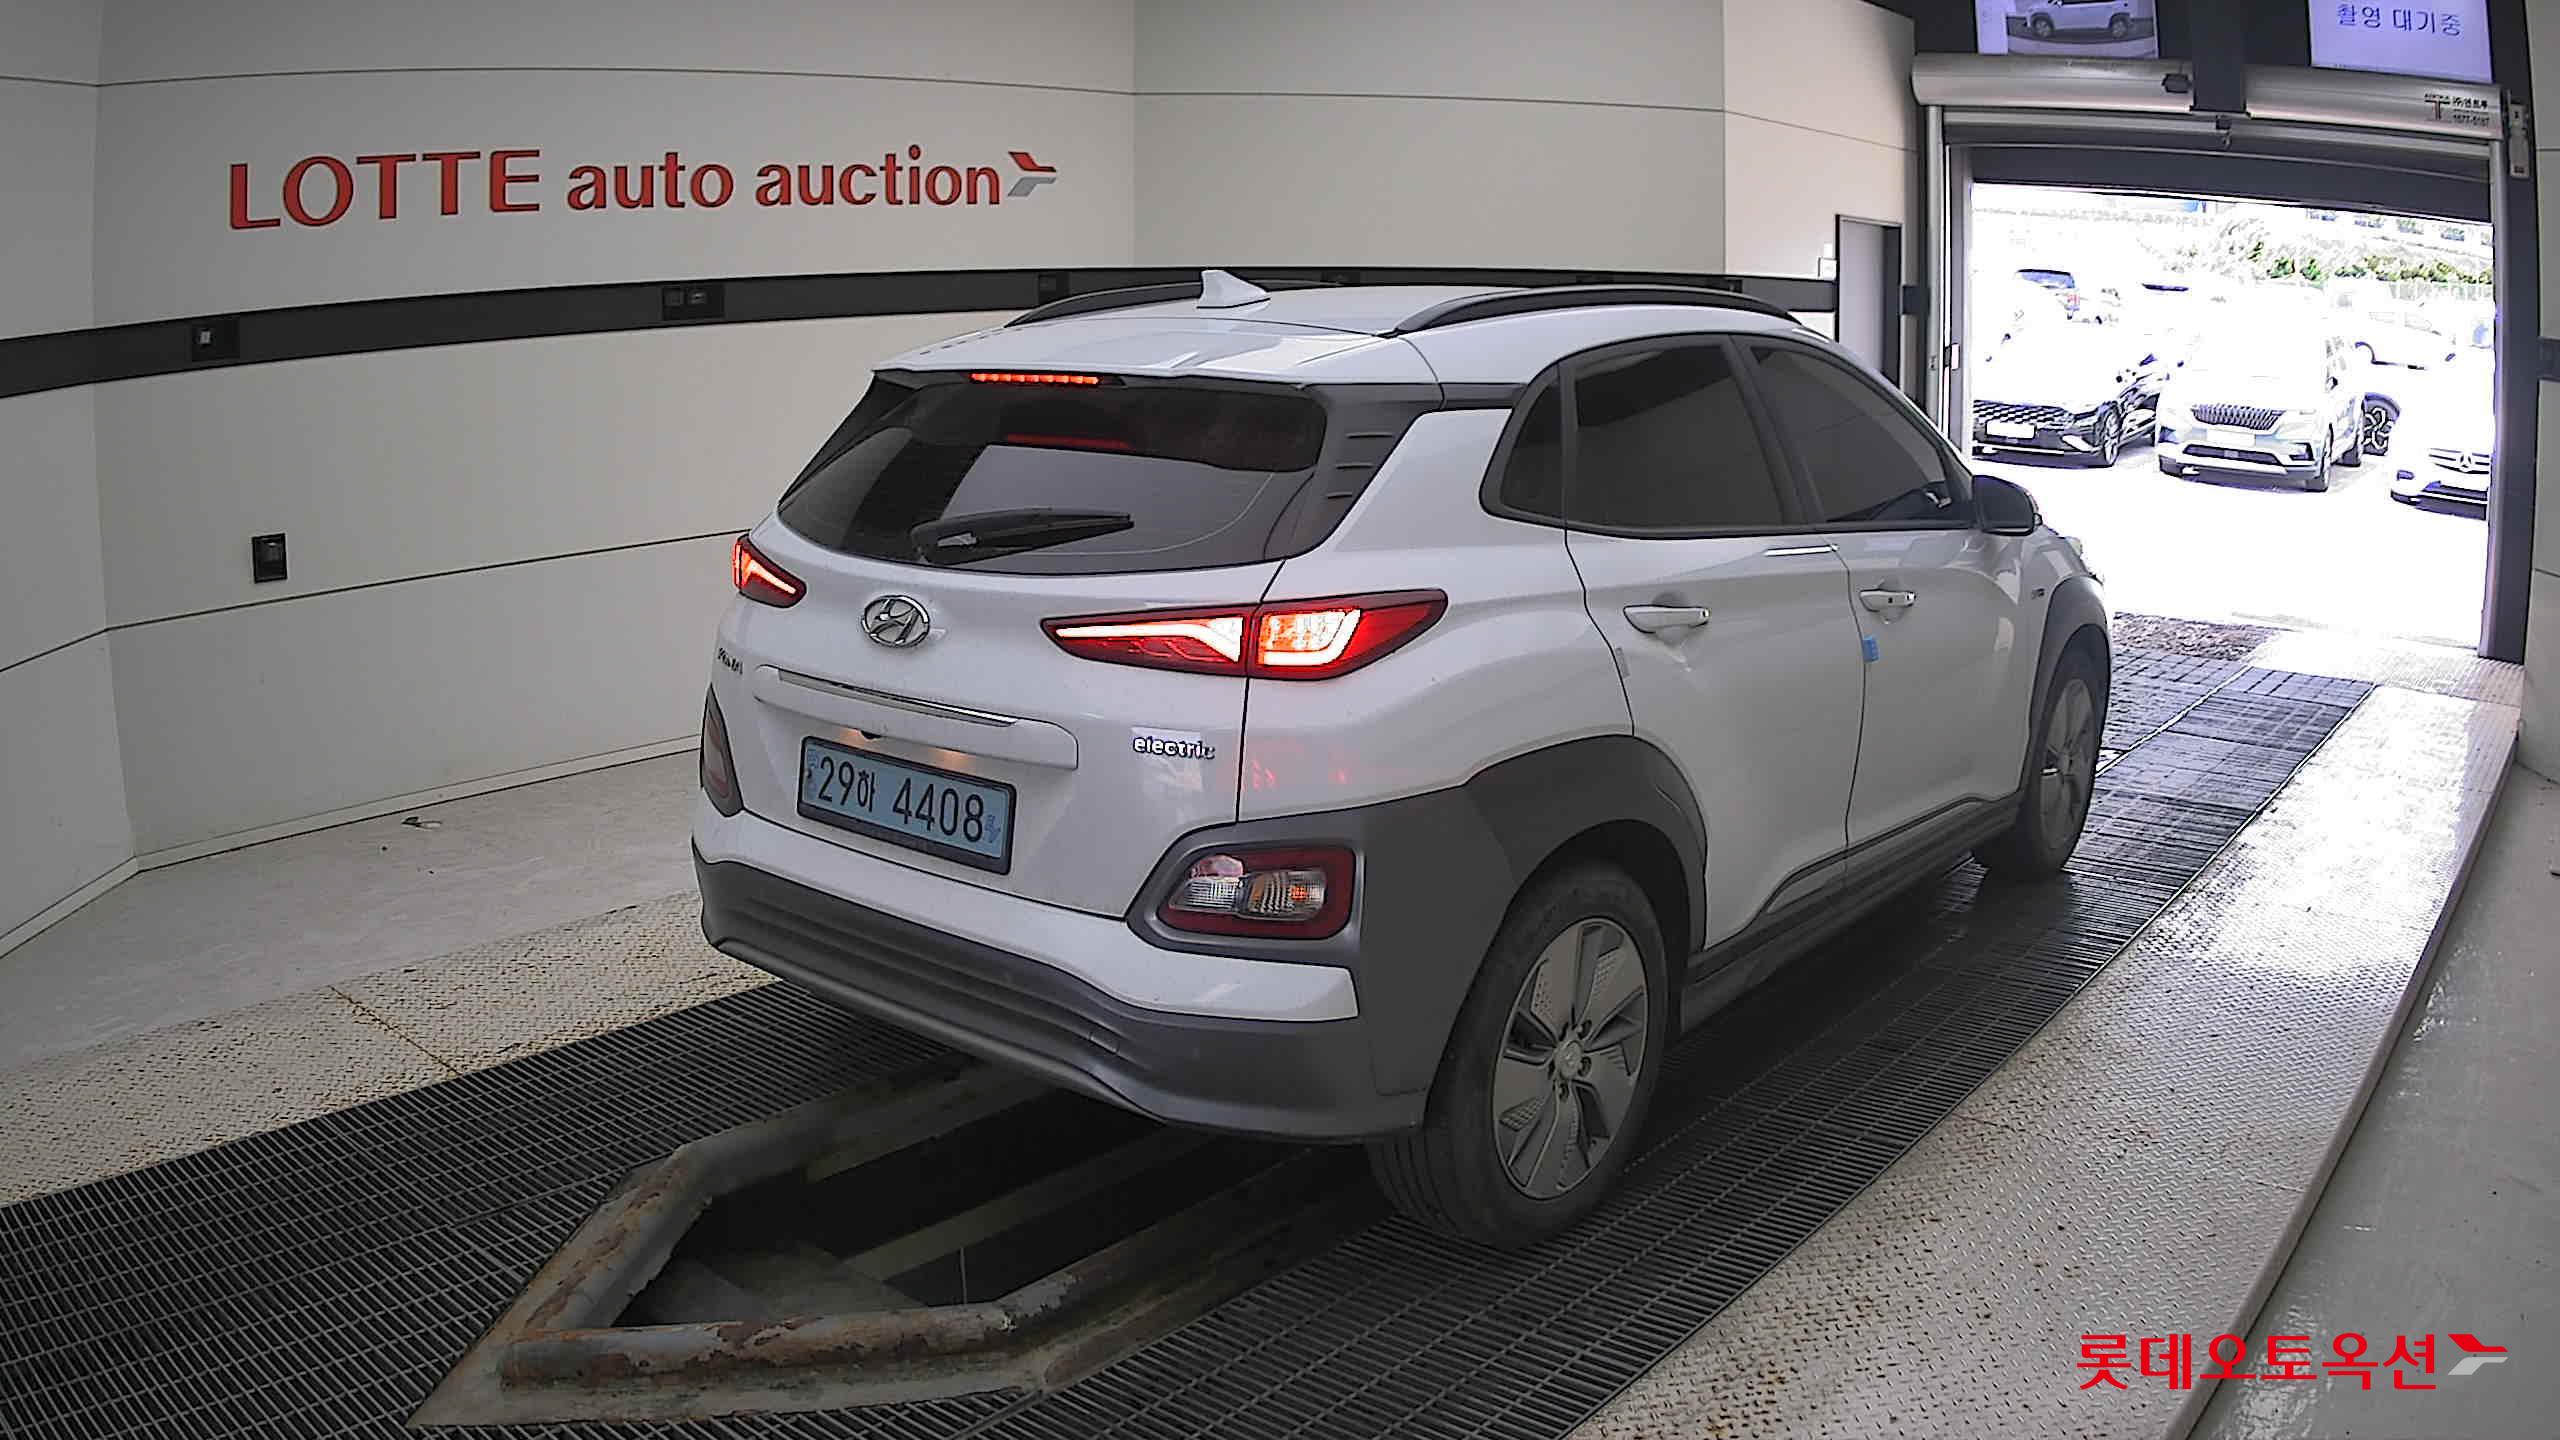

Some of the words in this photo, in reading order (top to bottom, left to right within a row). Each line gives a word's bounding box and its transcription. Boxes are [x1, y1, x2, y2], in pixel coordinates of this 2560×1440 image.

[2338, 4, 2381, 29] 촬영
[2392, 8, 2462, 37] 대기중
[229, 148, 542, 231] LOTTE
[567, 150, 735, 210] auto
[755, 144, 1001, 208] auction
[1132, 735, 1216, 760] electric
[818, 756, 876, 813] 29하
[892, 776, 985, 843] 4408
